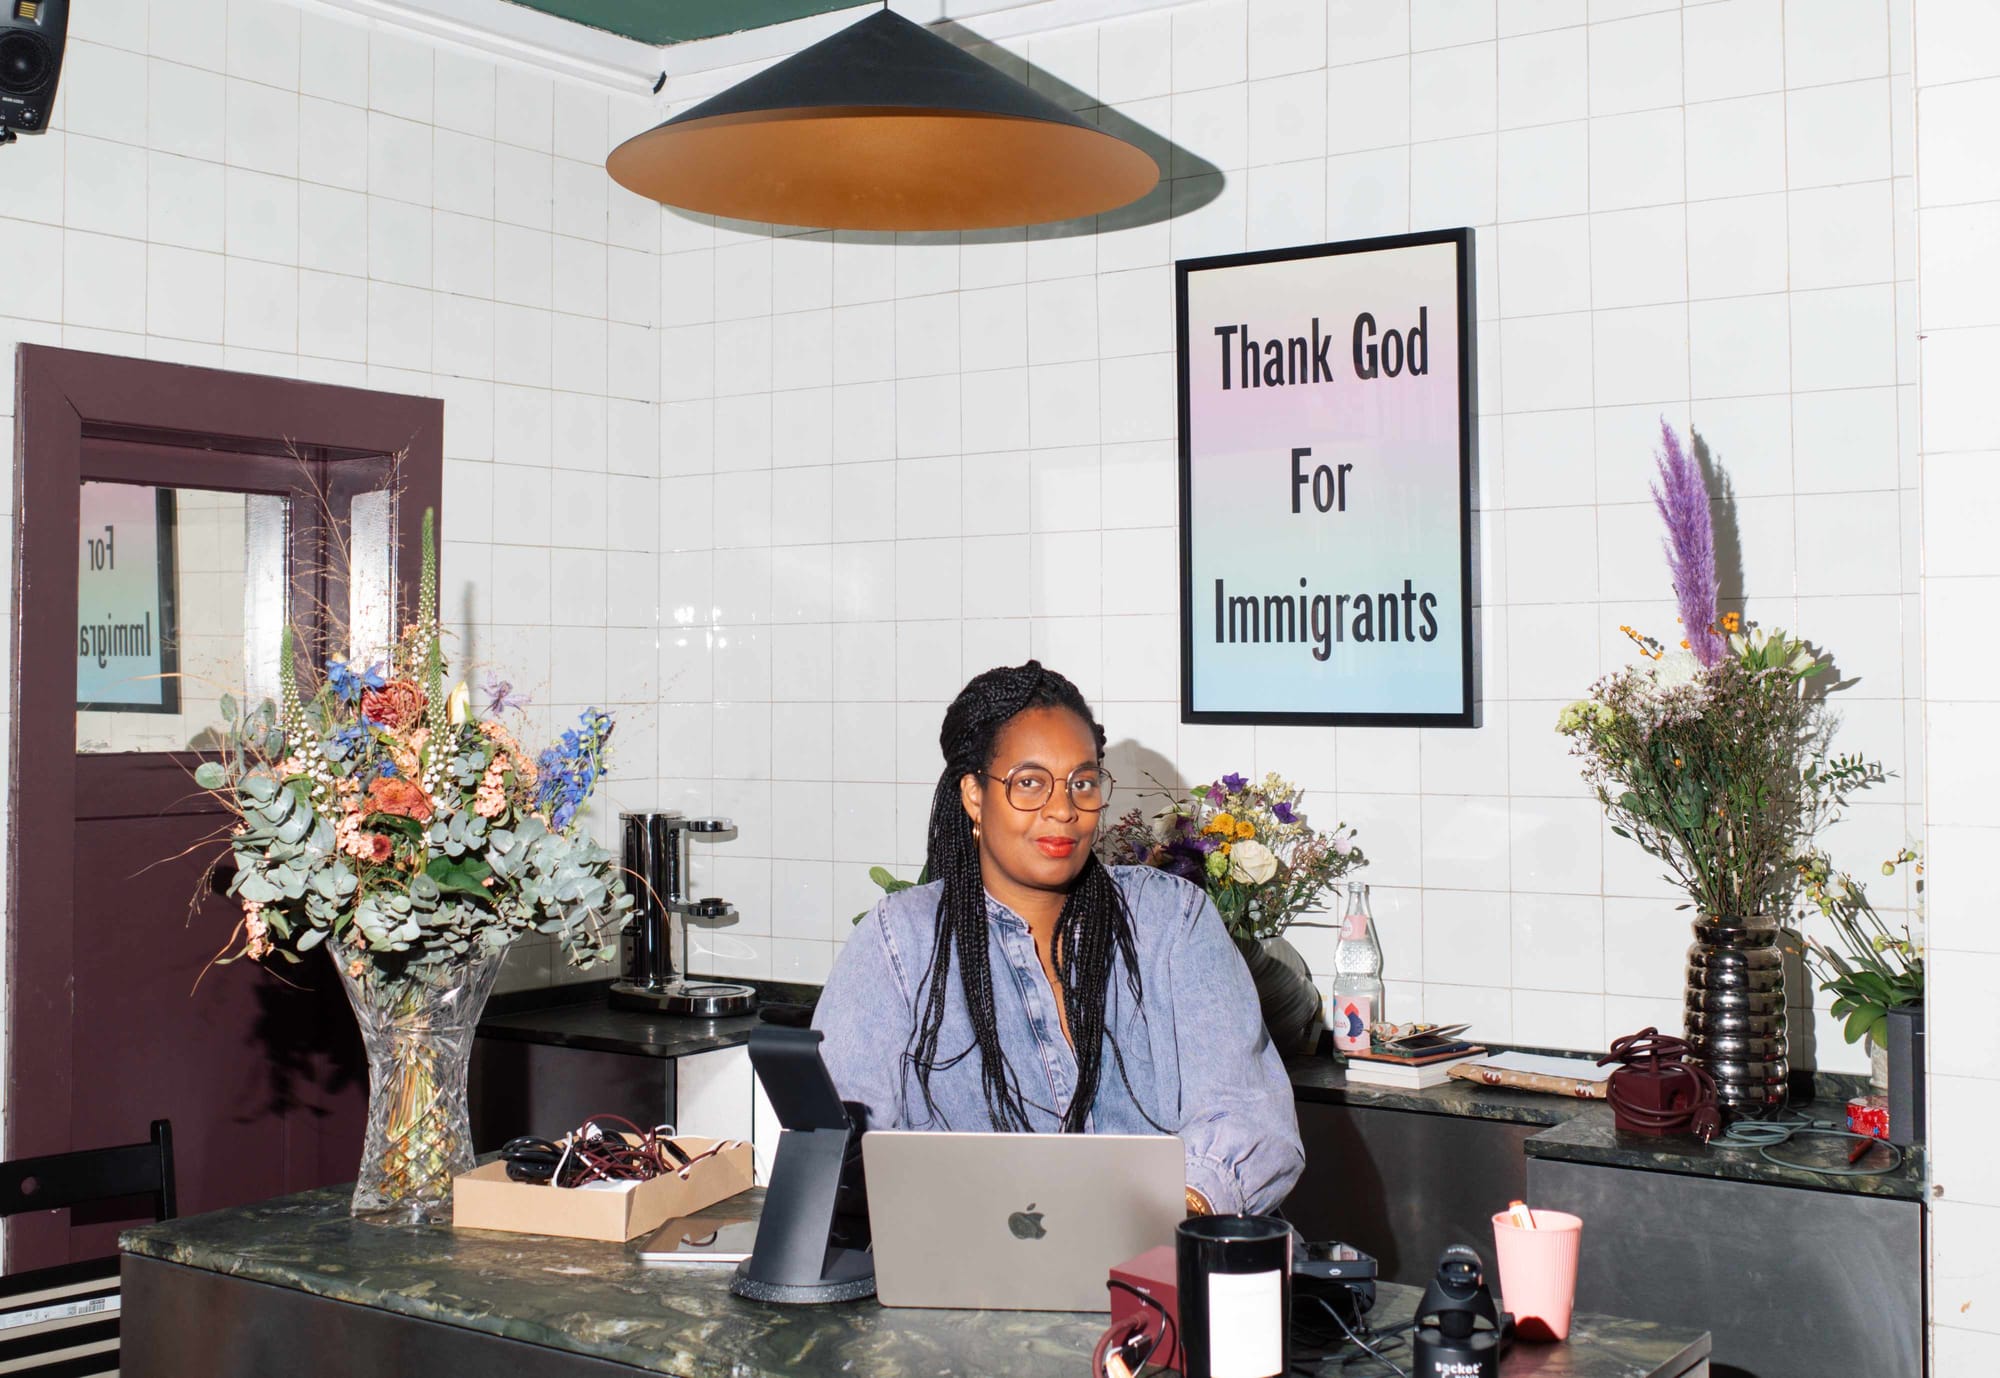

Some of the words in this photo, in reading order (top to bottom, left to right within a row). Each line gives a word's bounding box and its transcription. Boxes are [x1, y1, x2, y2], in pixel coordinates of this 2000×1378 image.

[1214, 317, 1334, 390] Thank
[1352, 306, 1428, 380] God
[1291, 447, 1353, 514] For
[1215, 577, 1438, 661] Immigrants
